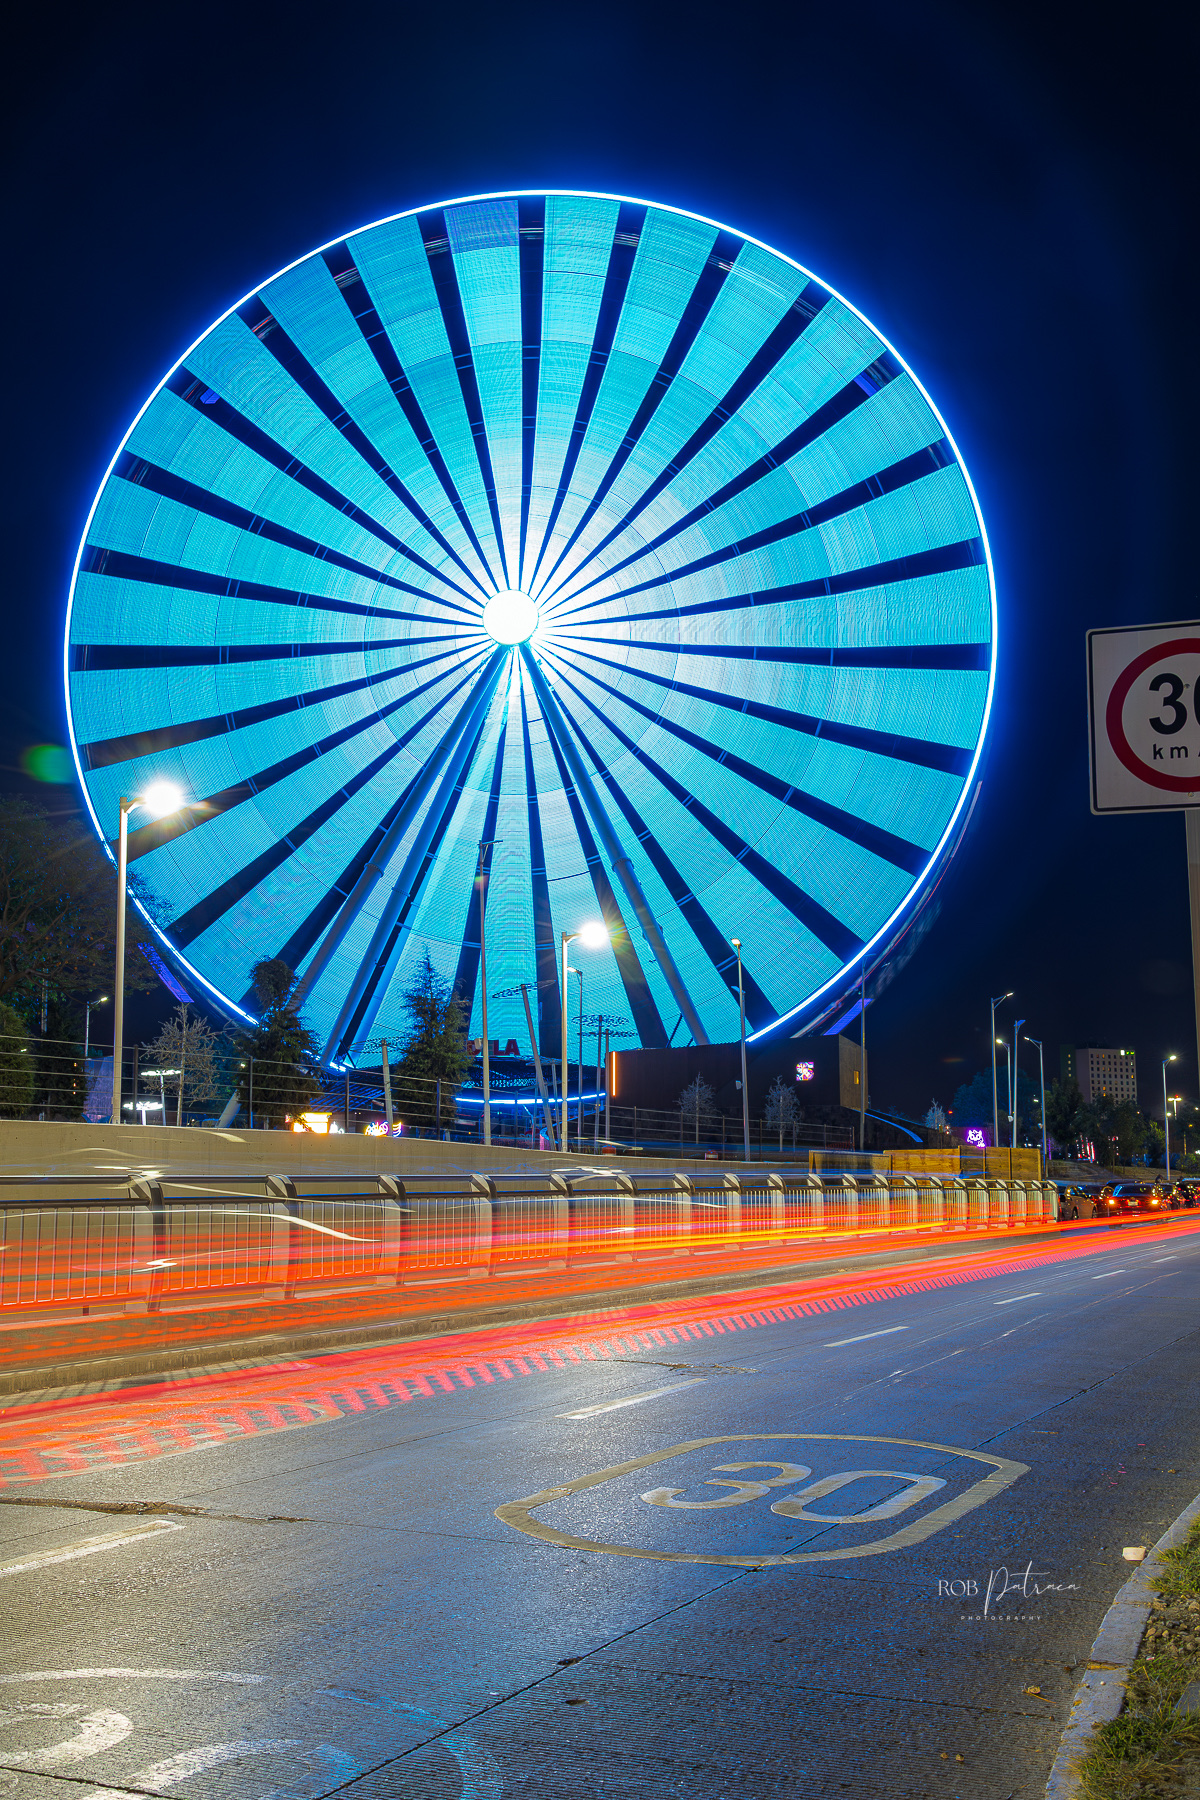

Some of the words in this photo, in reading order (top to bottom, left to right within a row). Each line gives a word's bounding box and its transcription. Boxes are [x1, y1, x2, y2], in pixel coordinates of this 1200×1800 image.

[1149, 673, 1200, 735] 3
[1152, 743, 1200, 760] km
[641, 1462, 947, 1523] 30
